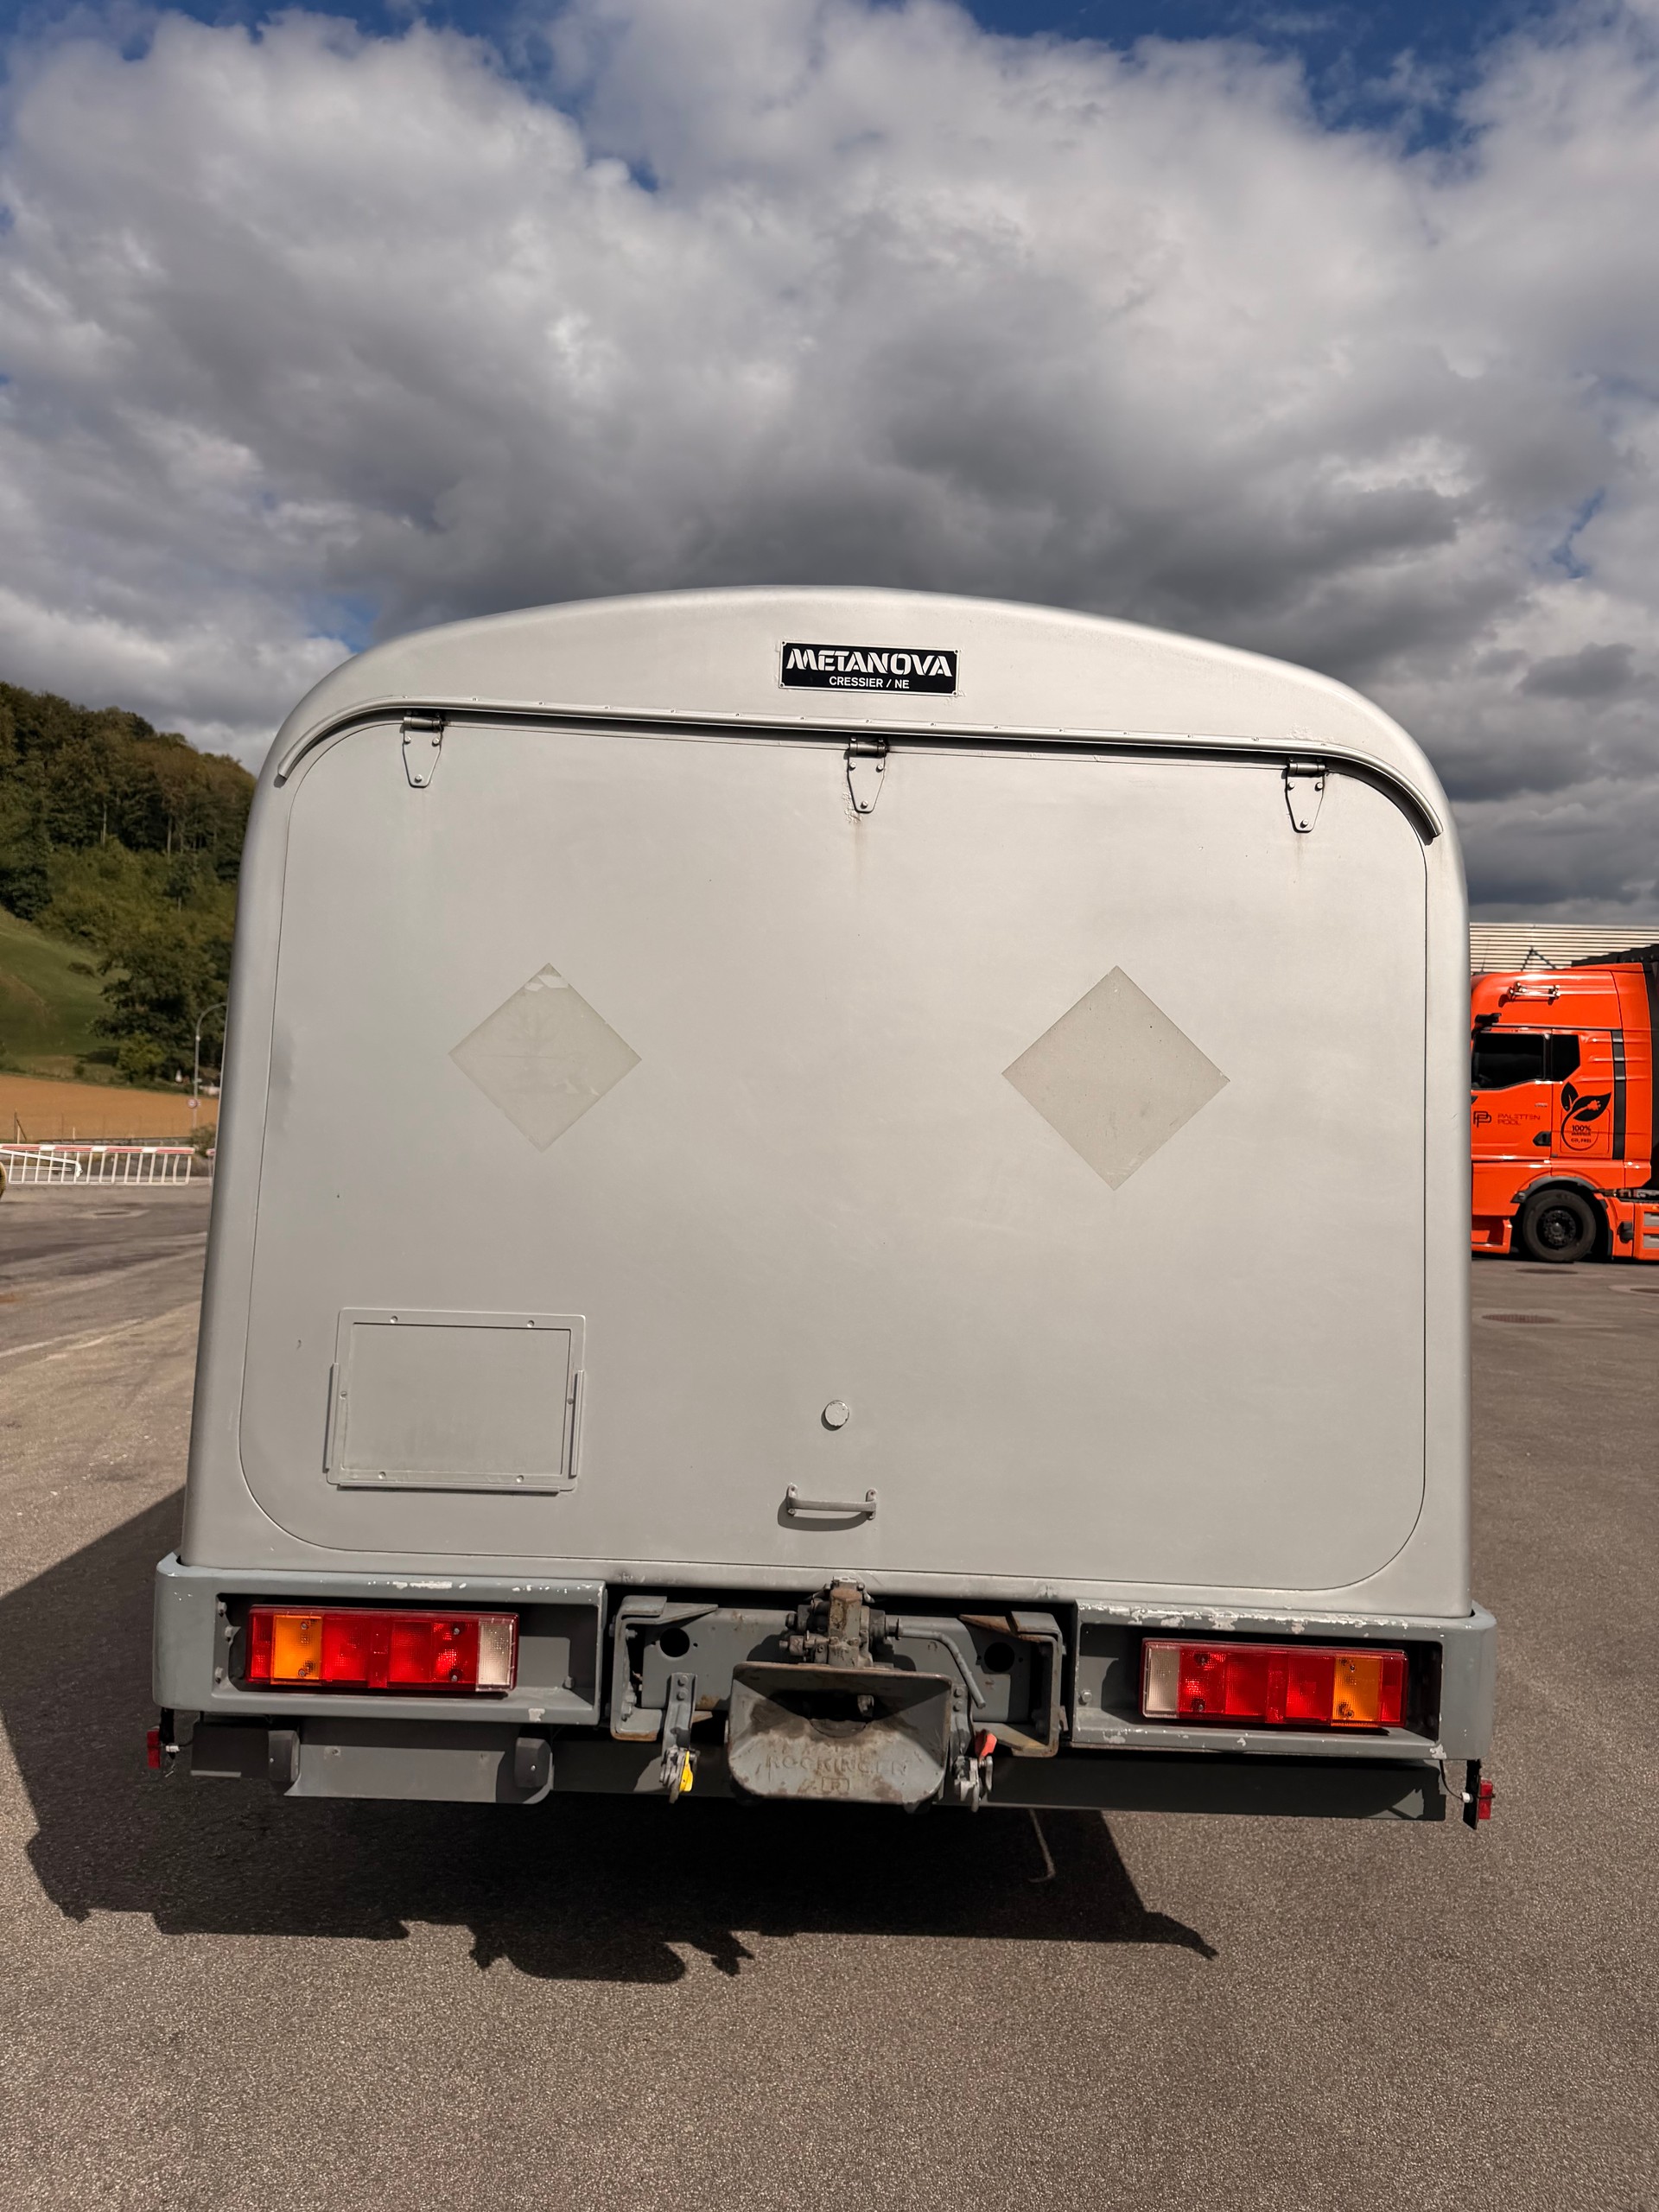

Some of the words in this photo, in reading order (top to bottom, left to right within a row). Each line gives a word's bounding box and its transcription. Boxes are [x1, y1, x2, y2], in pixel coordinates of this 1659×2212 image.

[785, 648, 953, 677] METANOVA
[829, 676, 883, 689] CRESSIER
[894, 678, 910, 690] NE
